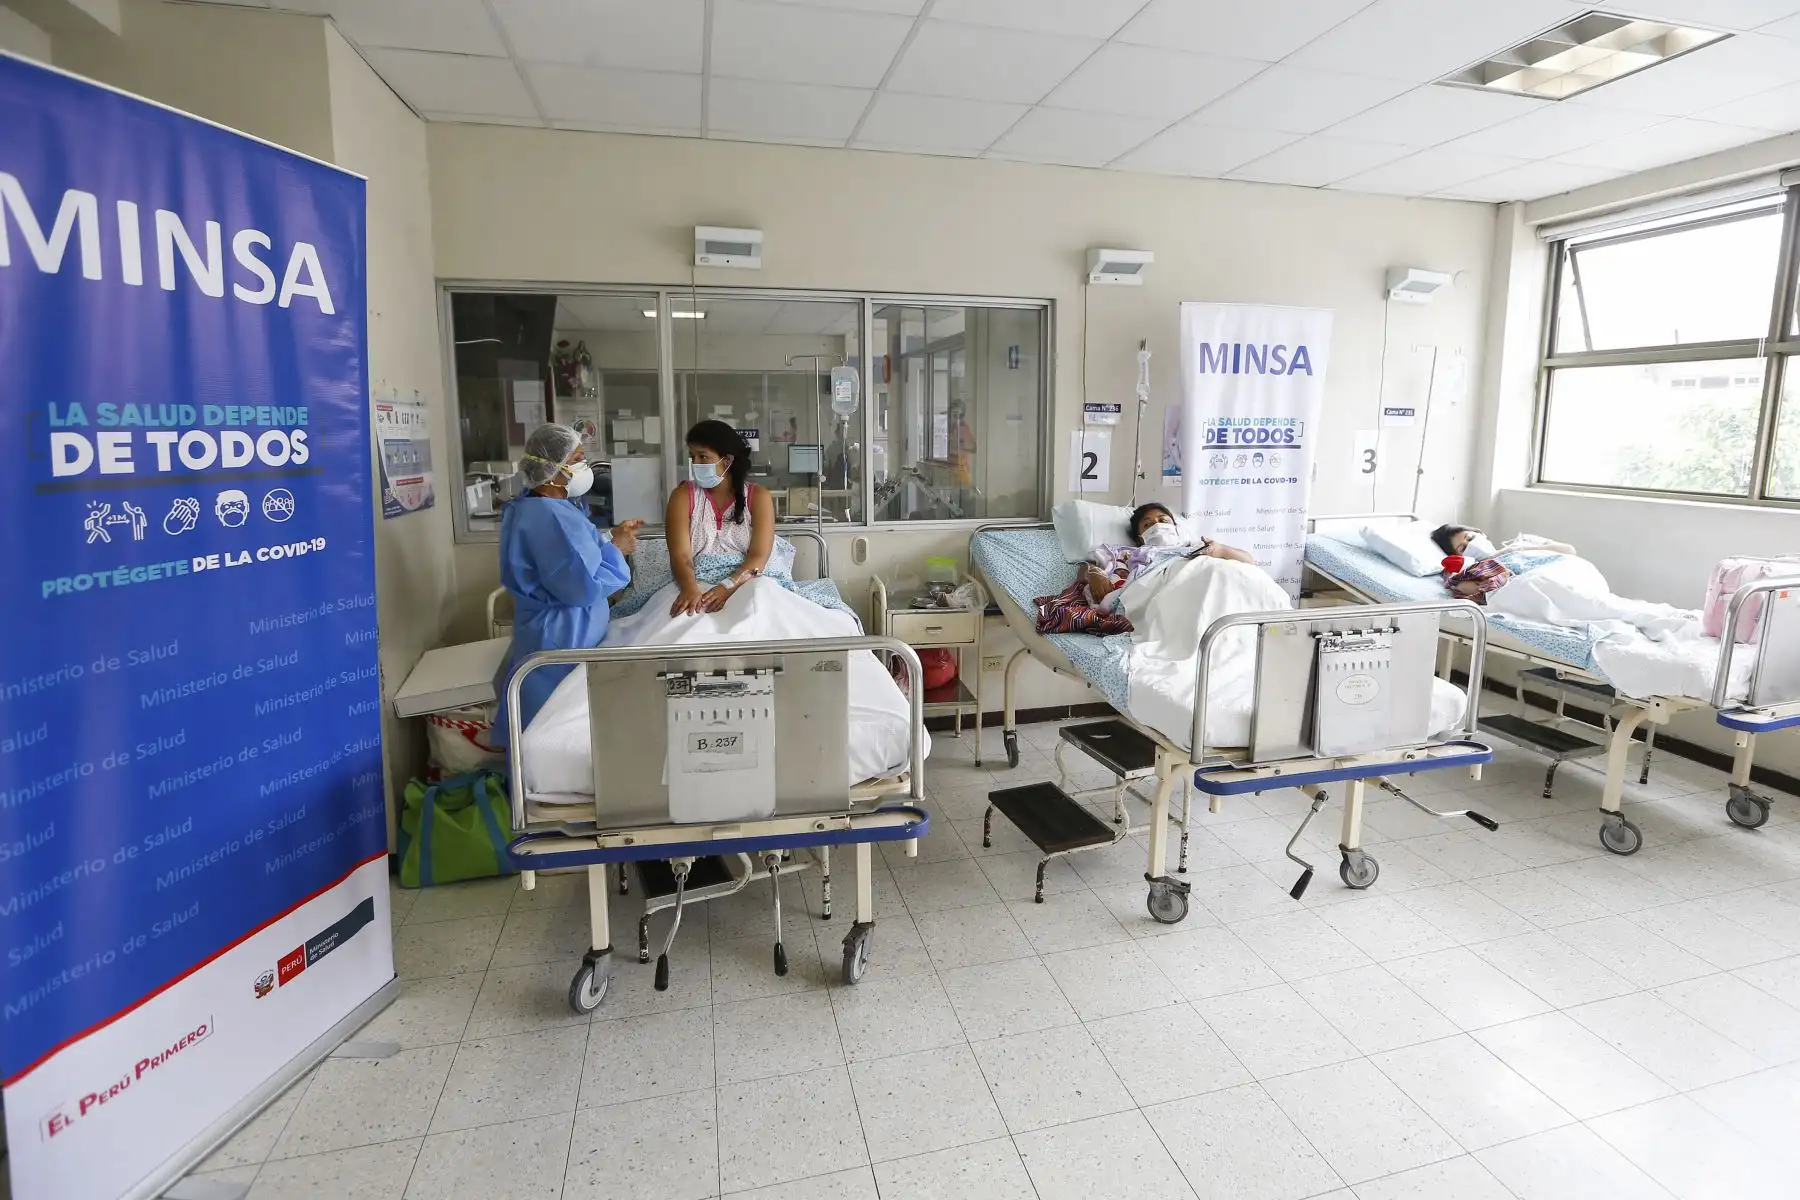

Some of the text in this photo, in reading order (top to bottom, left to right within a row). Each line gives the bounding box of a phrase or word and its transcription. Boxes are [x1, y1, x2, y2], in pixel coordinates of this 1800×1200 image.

[0, 171, 335, 315] MINSA
[1199, 342, 1313, 376] MINSA
[49, 402, 308, 427] LA SALUD DEPENDE
[1206, 427, 1295, 444] DE TODOS
[1207, 417, 1296, 427] LA SALUD DEPENDE
[50, 429, 310, 477] DE TODOS
[1081, 452, 1098, 480] 2
[1362, 449, 1377, 474] 3
[1252, 477, 1262, 485] LA
[1264, 477, 1298, 485] COVID-19
[41, 537, 326, 599] PROTÉGETE DE LA COVID-19
[249, 593, 375, 635] Ministerio de Salud
[345, 627, 378, 645] Mini
[0, 639, 179, 701] inisterio de Salud
[140, 650, 299, 710] Ministerio de Salud
[254, 664, 377, 717] Ministerio de Salud
[669, 678, 689, 690] 237
[348, 699, 380, 717] Mini
[0, 722, 48, 754] alud
[102, 750, 130, 770] de
[136, 728, 186, 760] Salud
[715, 736, 738, 748] 237
[148, 727, 303, 799] Ministerio de Salud
[260, 733, 380, 798] Ministerio de Salud
[0, 820, 55, 862] Salud
[156, 804, 306, 893] Ministerio de Salud
[265, 831, 335, 877] Ministerio
[348, 802, 384, 826] Salud
[0, 816, 193, 917] Ministerio de Salud
[4, 901, 200, 1021] Ministerio de Salud
[7, 920, 64, 968] Salud
[281, 932, 339, 975] PERÚ Ministerio
[309, 941, 335, 961] de Salud
